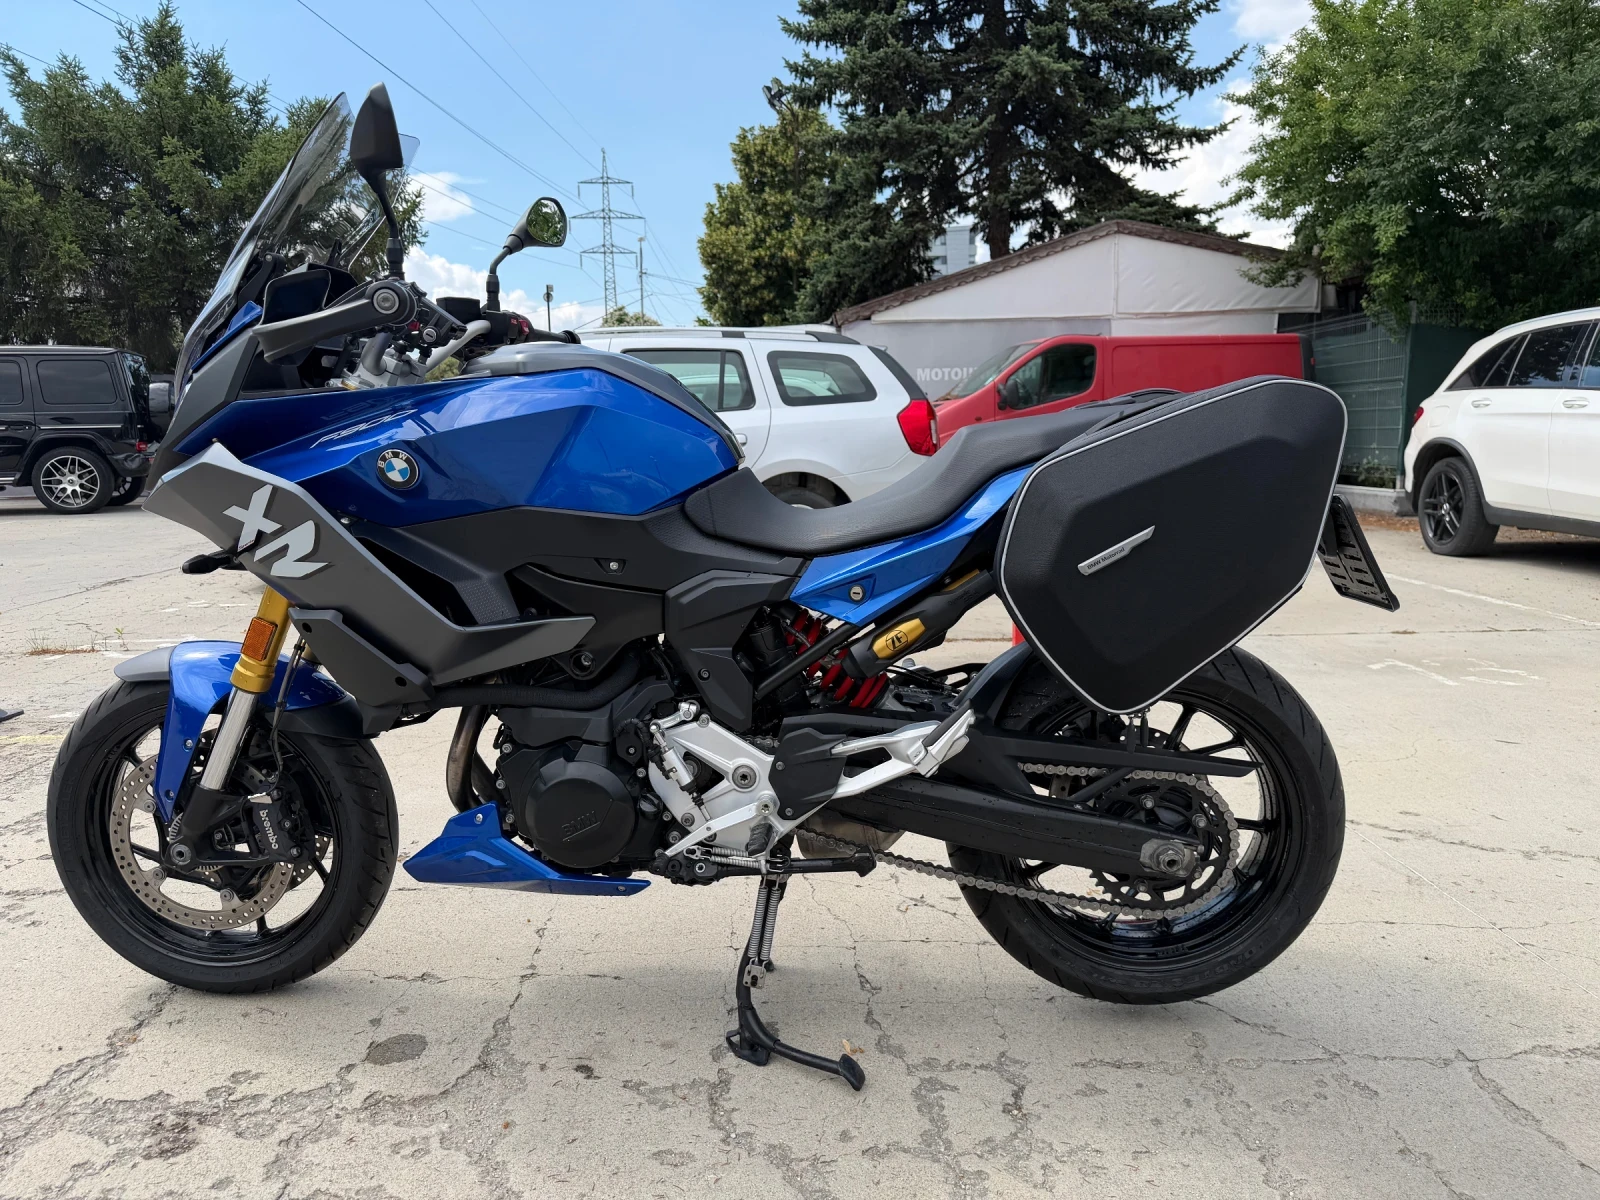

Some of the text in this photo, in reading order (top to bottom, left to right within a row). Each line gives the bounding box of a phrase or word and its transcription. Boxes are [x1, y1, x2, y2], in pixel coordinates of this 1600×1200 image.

[378, 451, 407, 468] BMW
[222, 484, 329, 578] XR
[1087, 560, 1101, 570] BMW
[886, 629, 908, 651] ZF
[260, 809, 279, 850] brembo
[561, 810, 599, 837] BMW
